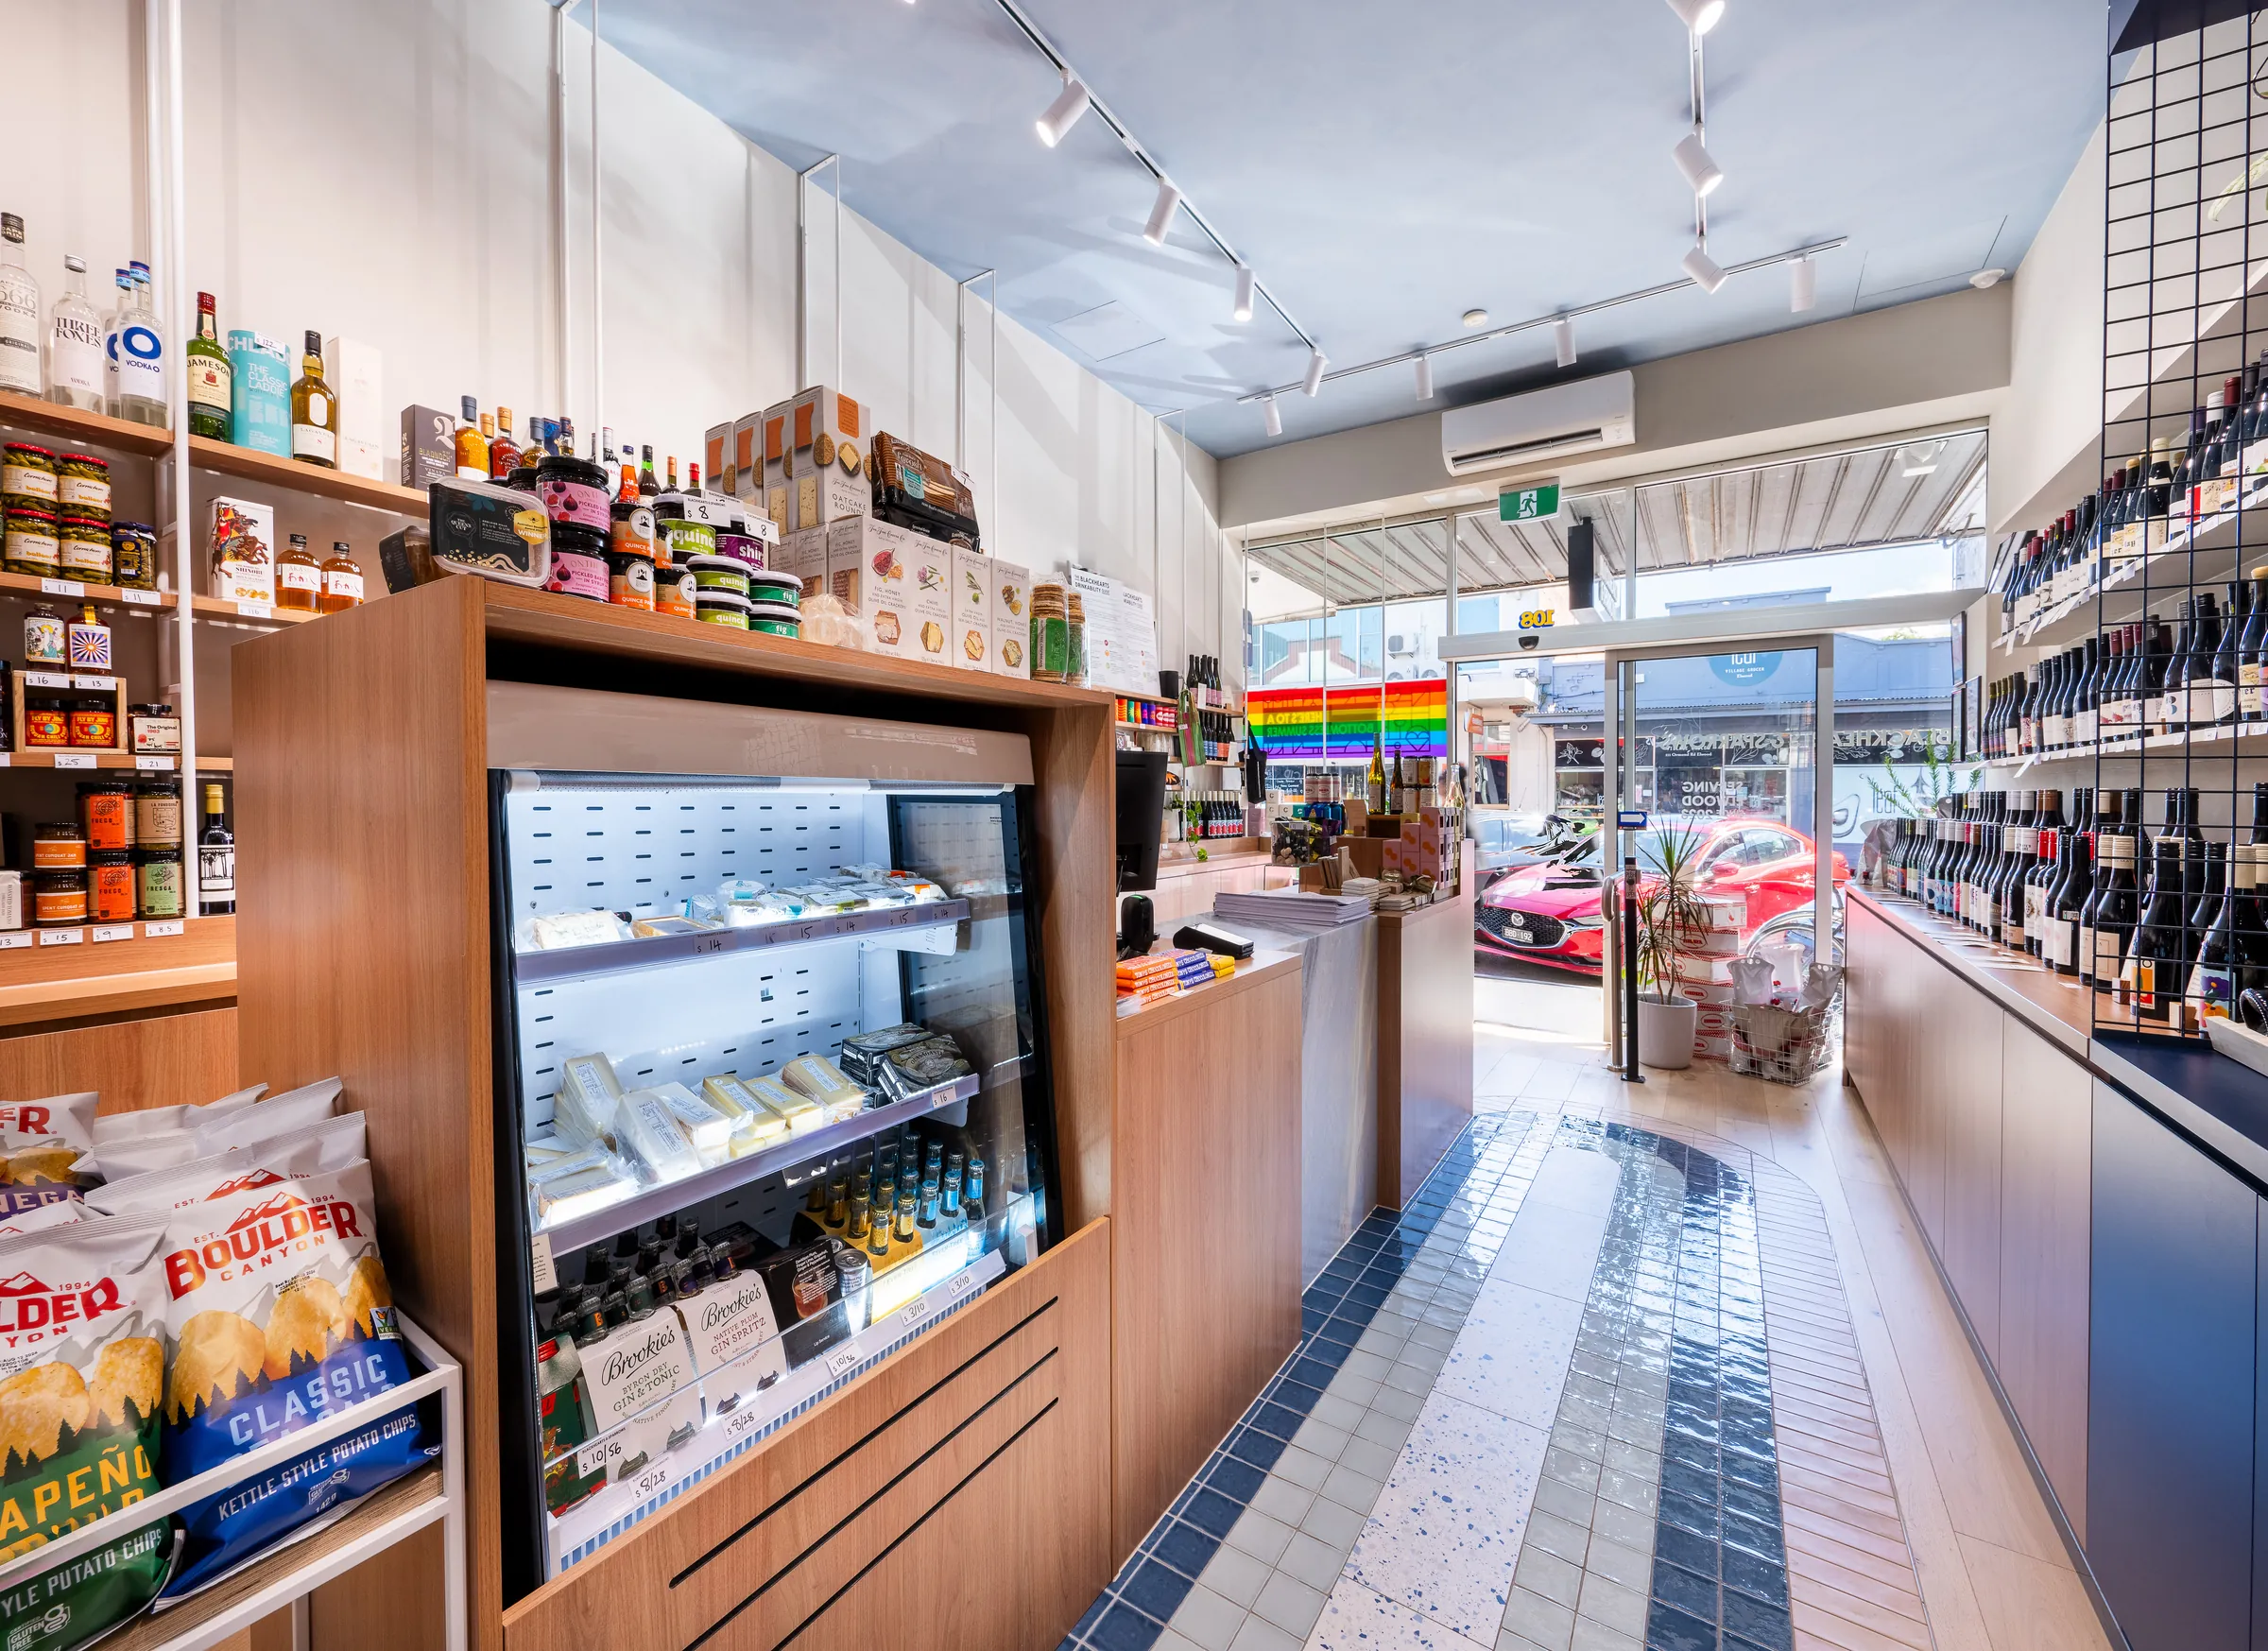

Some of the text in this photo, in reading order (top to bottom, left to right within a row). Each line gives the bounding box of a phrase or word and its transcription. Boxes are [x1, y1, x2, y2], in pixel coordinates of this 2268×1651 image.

[56, 317, 100, 337] THREE
[56, 327, 101, 348] FOXES
[126, 359, 151, 371] VODKA
[186, 358, 230, 378] JAMESON
[249, 363, 268, 374] THE
[249, 371, 288, 391] CLASSIC
[249, 380, 285, 399] LADDIE
[832, 493, 868, 511] OATCAKE
[698, 506, 709, 519] 8
[518, 529, 547, 540] WINNER
[761, 525, 766, 536] 8
[625, 542, 646, 551] QUINCE
[739, 544, 764, 561] shir
[572, 570, 593, 579] PICKLED
[1080, 575, 1109, 589] BLACKHEARTS
[885, 588, 901, 596] HONEY
[1074, 581, 1102, 593] DRINKABILITY
[782, 592, 793, 601] fig
[776, 624, 787, 635] fig
[38, 677, 49, 685] 16
[899, 913, 908, 923] 15
[940, 908, 949, 918] 14
[800, 926, 813, 938] 15
[846, 921, 855, 931] 14
[102, 930, 112, 939] 9
[709, 939, 722, 951] 14
[939, 1093, 948, 1103] 16
[174, 1197, 199, 1209] EST.
[193, 1195, 335, 1244] EST. 1994
[164, 1201, 363, 1301] BOULDER
[220, 1234, 325, 1281] CANYON
[59, 1281, 92, 1292] 1994
[954, 1275, 970, 1290] 3/10
[700, 1282, 762, 1332] Brookie's
[909, 1302, 925, 1318] 3/10
[713, 1312, 759, 1343] NATIVE PLUM
[711, 1316, 766, 1355] GIN SPRITZ
[601, 1325, 676, 1386] Brookie's
[836, 1354, 855, 1367] 10/36
[622, 1361, 668, 1395] BYRON DRY
[613, 1365, 680, 1412] GIN & TONIC
[229, 1353, 387, 1446] CLASSIC
[632, 1416, 654, 1424] NATIVE
[727, 1412, 755, 1436] $ 8/28
[582, 1437, 606, 1454] BLACKHEARTS
[608, 1427, 627, 1440] SPARROWS
[582, 1441, 622, 1472] $ 10/56
[218, 1478, 278, 1522] KETTLE
[282, 1452, 329, 1488] STYLE
[332, 1429, 379, 1463] POTATO
[382, 1414, 416, 1439] CHIPS
[635, 1470, 666, 1498] $ 8/28
[316, 1497, 331, 1514] 142
[123, 1529, 162, 1559] CHIPS
[10, 1622, 45, 1643] GLUTEN
[10, 1636, 32, 1651] FREE
